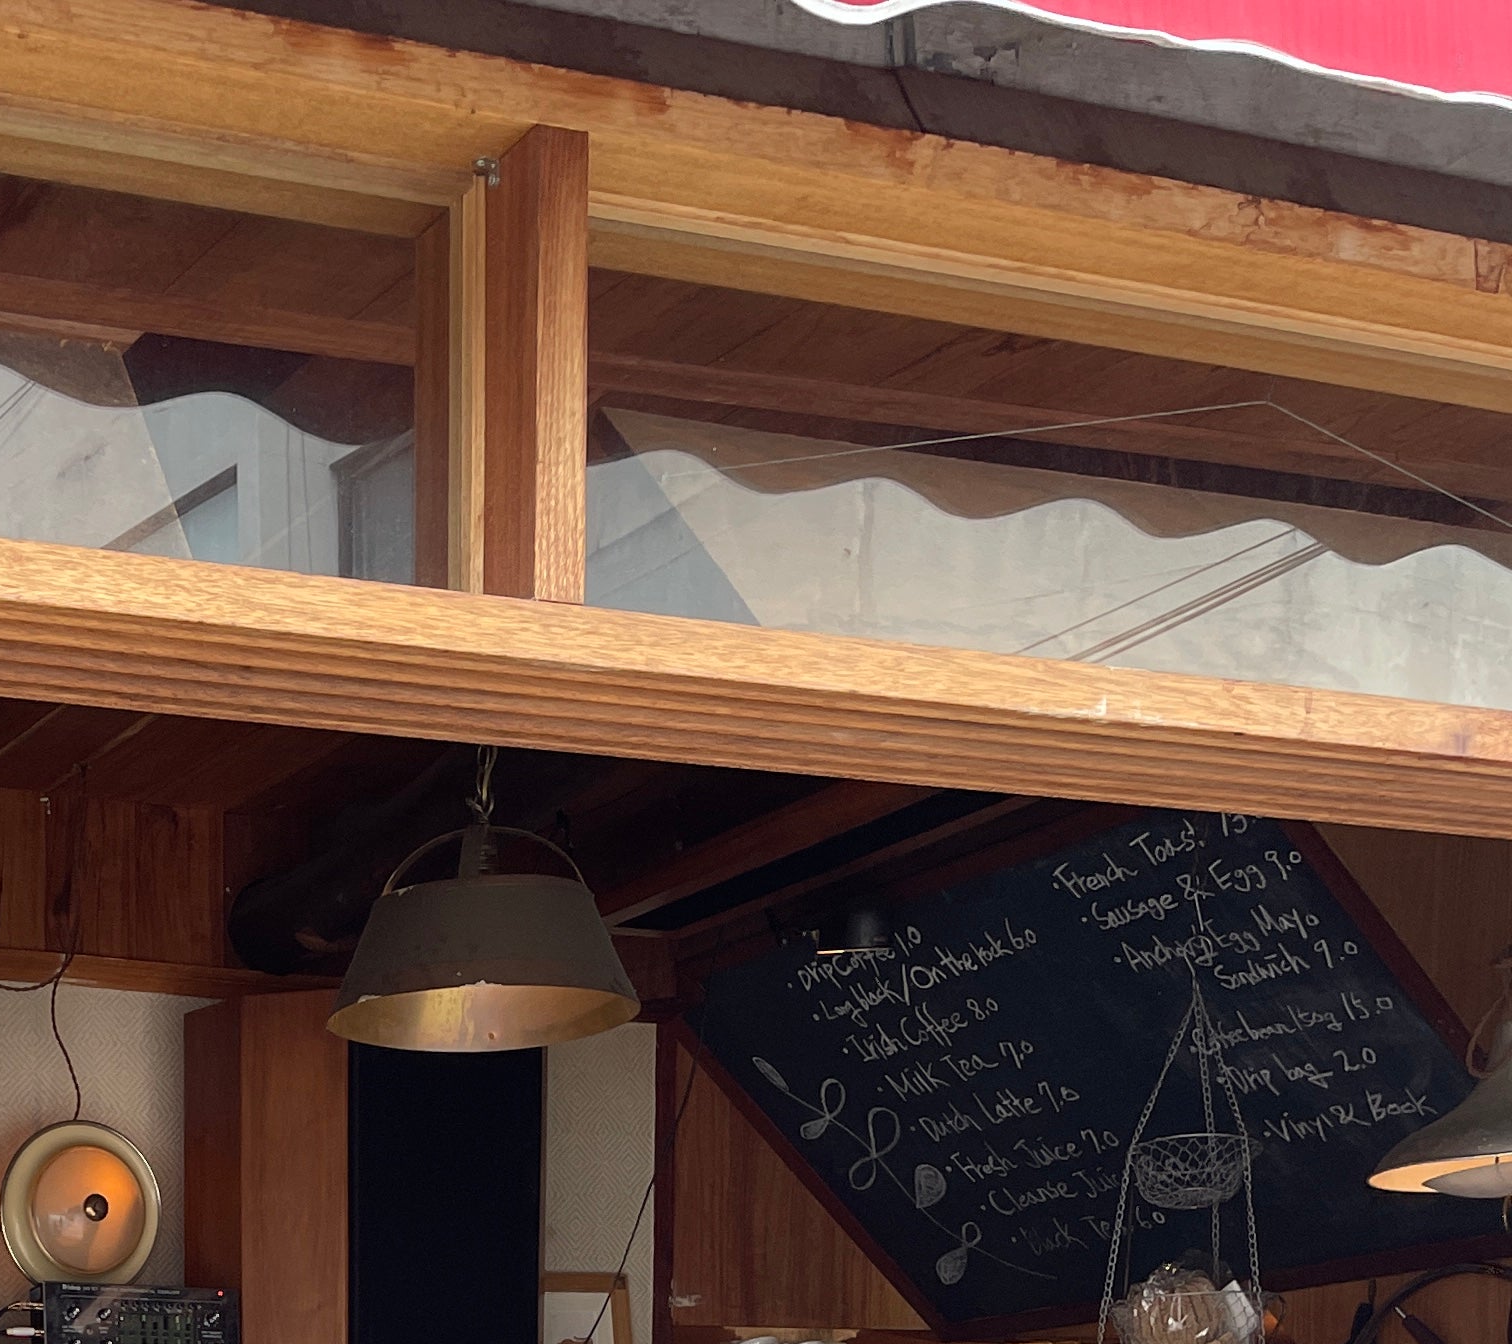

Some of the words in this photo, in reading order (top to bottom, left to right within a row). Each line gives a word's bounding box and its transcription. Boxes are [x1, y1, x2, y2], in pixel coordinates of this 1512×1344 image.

[1054, 853, 1138, 899] French
[1091, 893, 1179, 931] Sausage
[1208, 858, 1267, 892] Egg
[1264, 849, 1302, 881] 9.0
[1205, 918, 1261, 953] Egg
[1250, 904, 1320, 940] Mayo
[1214, 943, 1311, 990] Sandwich
[1313, 939, 1359, 970] 9.0
[900, 1002, 969, 1047] Coffee
[966, 997, 999, 1021] 8.0
[885, 1060, 951, 1102] Milk
[940, 1053, 999, 1082] Tea
[1271, 1052, 1335, 1090] bag
[1333, 1047, 1377, 1073] 2.0
[918, 1101, 983, 1142] Dutch
[972, 1088, 1042, 1125] Latte
[1365, 1088, 1439, 1122] Book
[950, 1140, 1018, 1183] Fresh
[1013, 1137, 1083, 1169] Juice
[988, 1181, 1078, 1216] Cleanse
